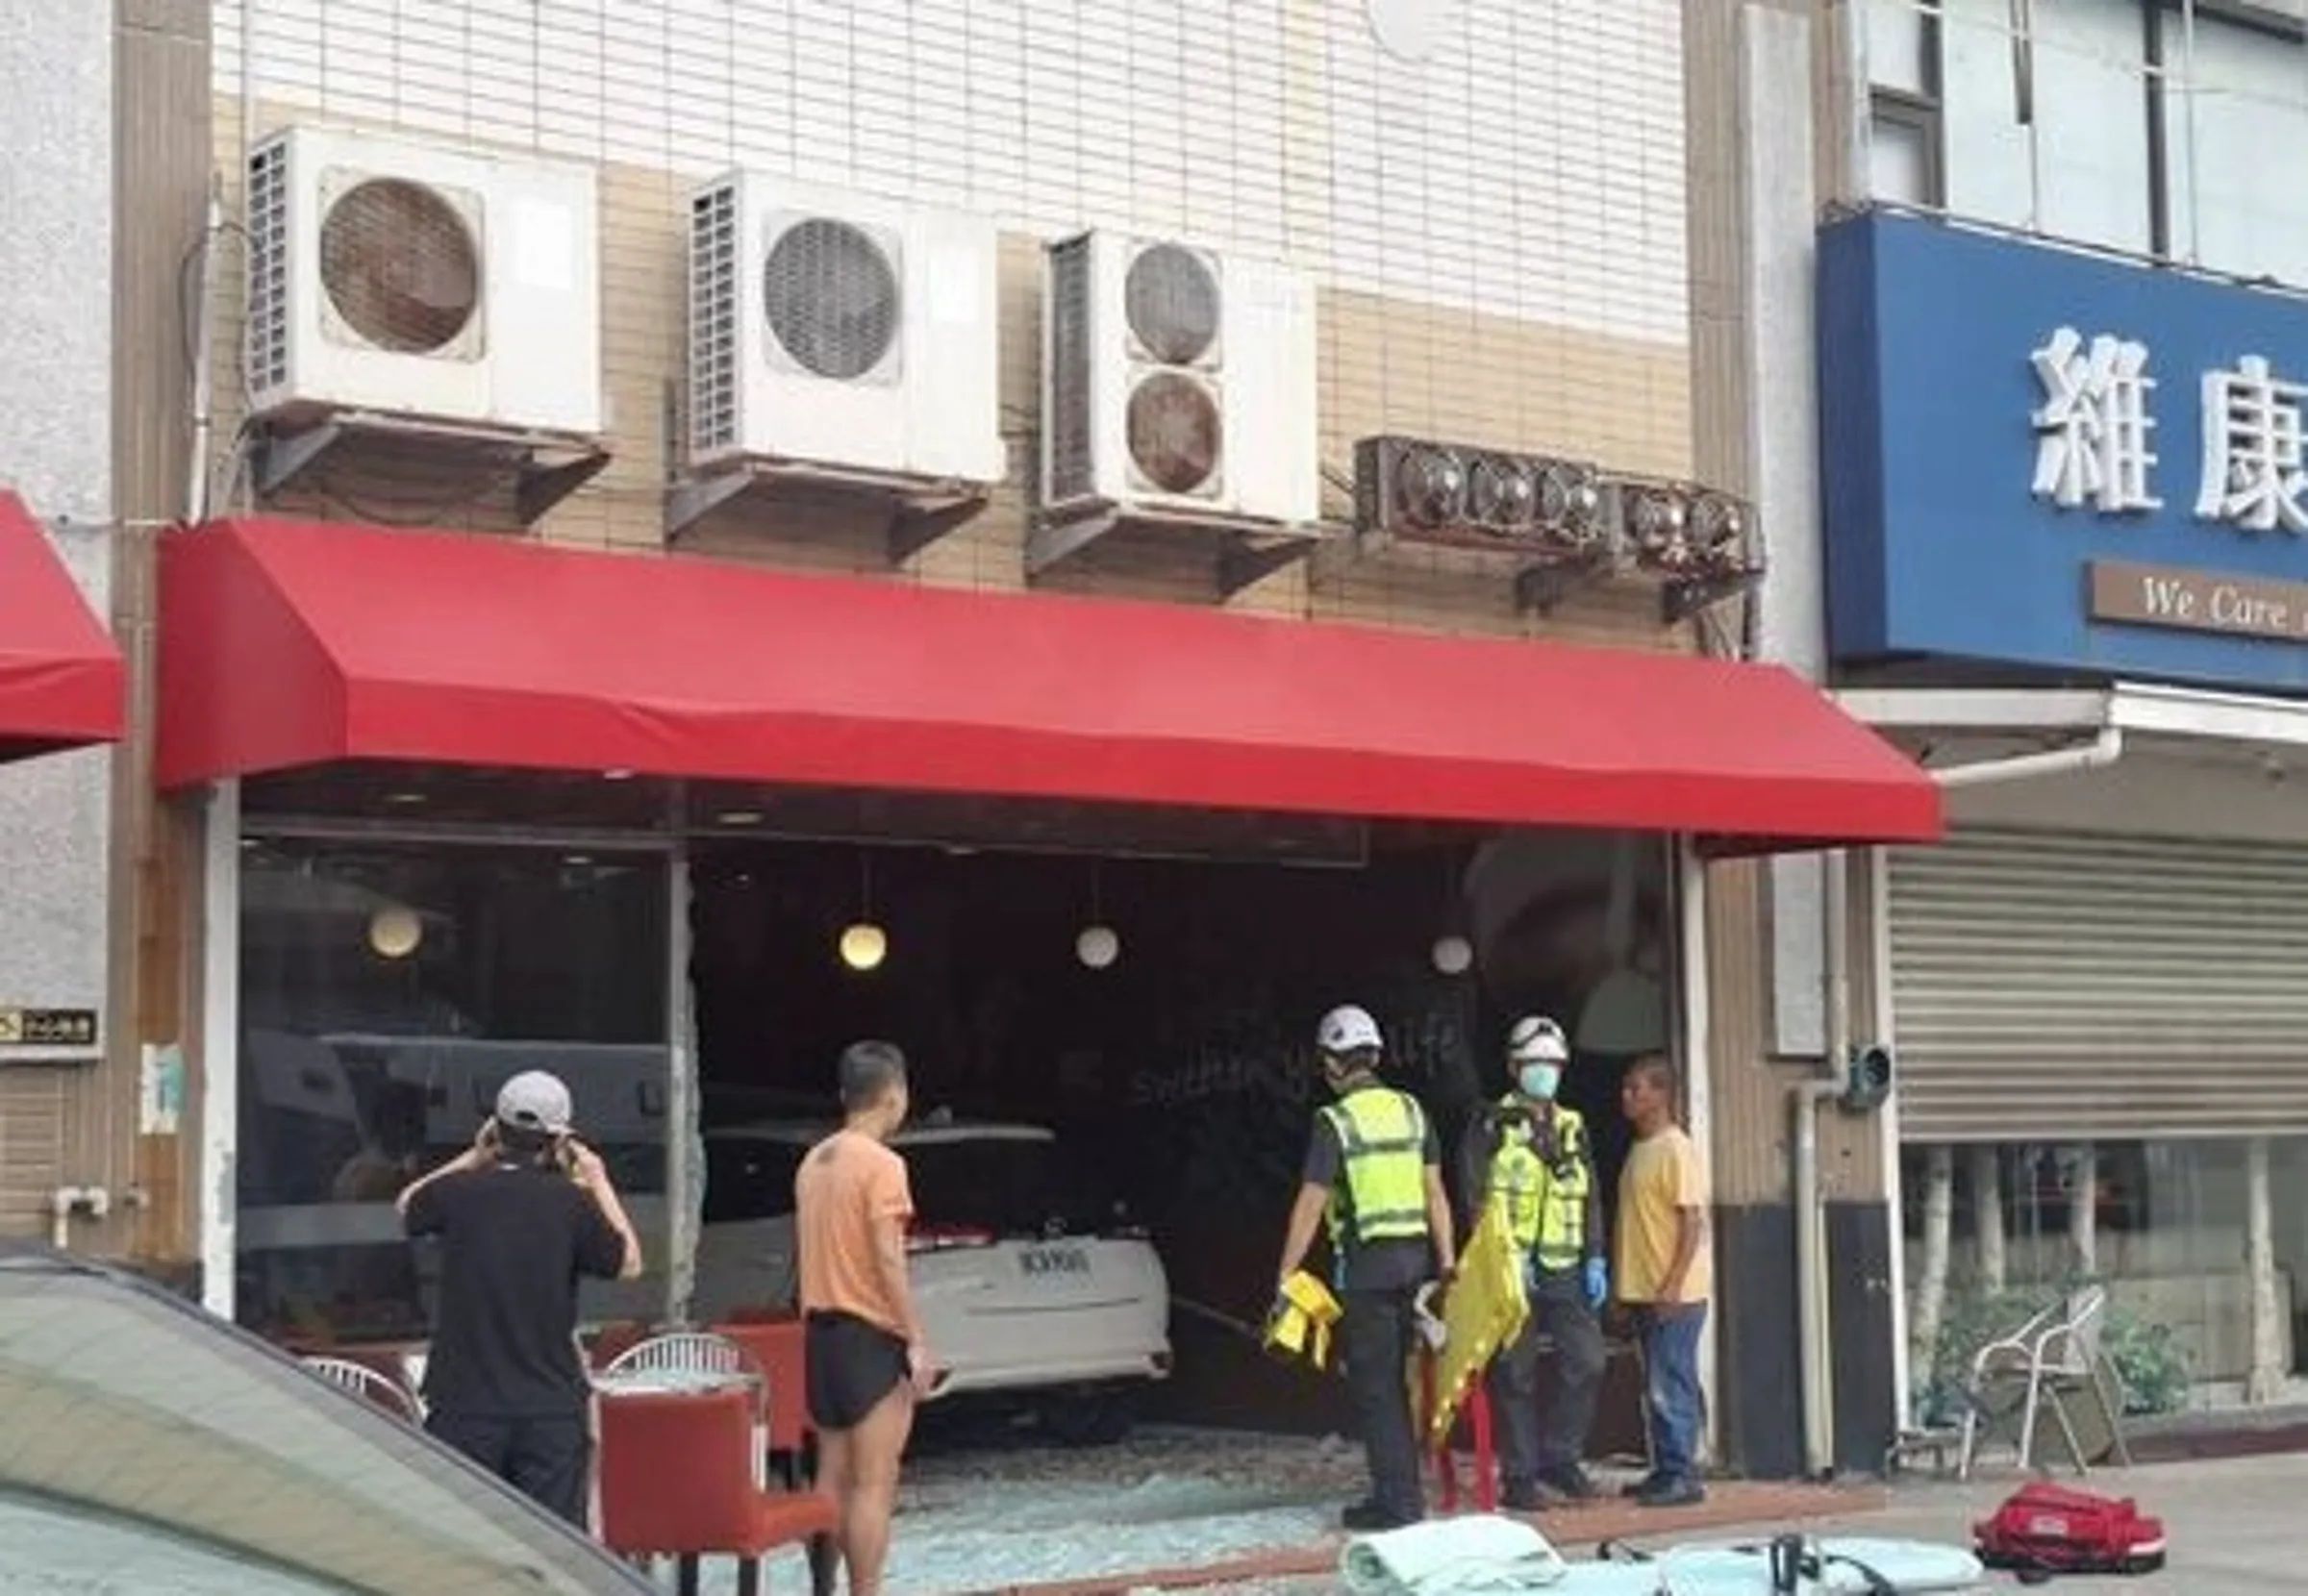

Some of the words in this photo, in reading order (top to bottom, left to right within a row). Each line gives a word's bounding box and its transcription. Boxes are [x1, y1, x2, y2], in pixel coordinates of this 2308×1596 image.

[2029, 325, 2308, 533] 維康
[2143, 576, 2195, 616] We
[2210, 584, 2288, 629] Care
